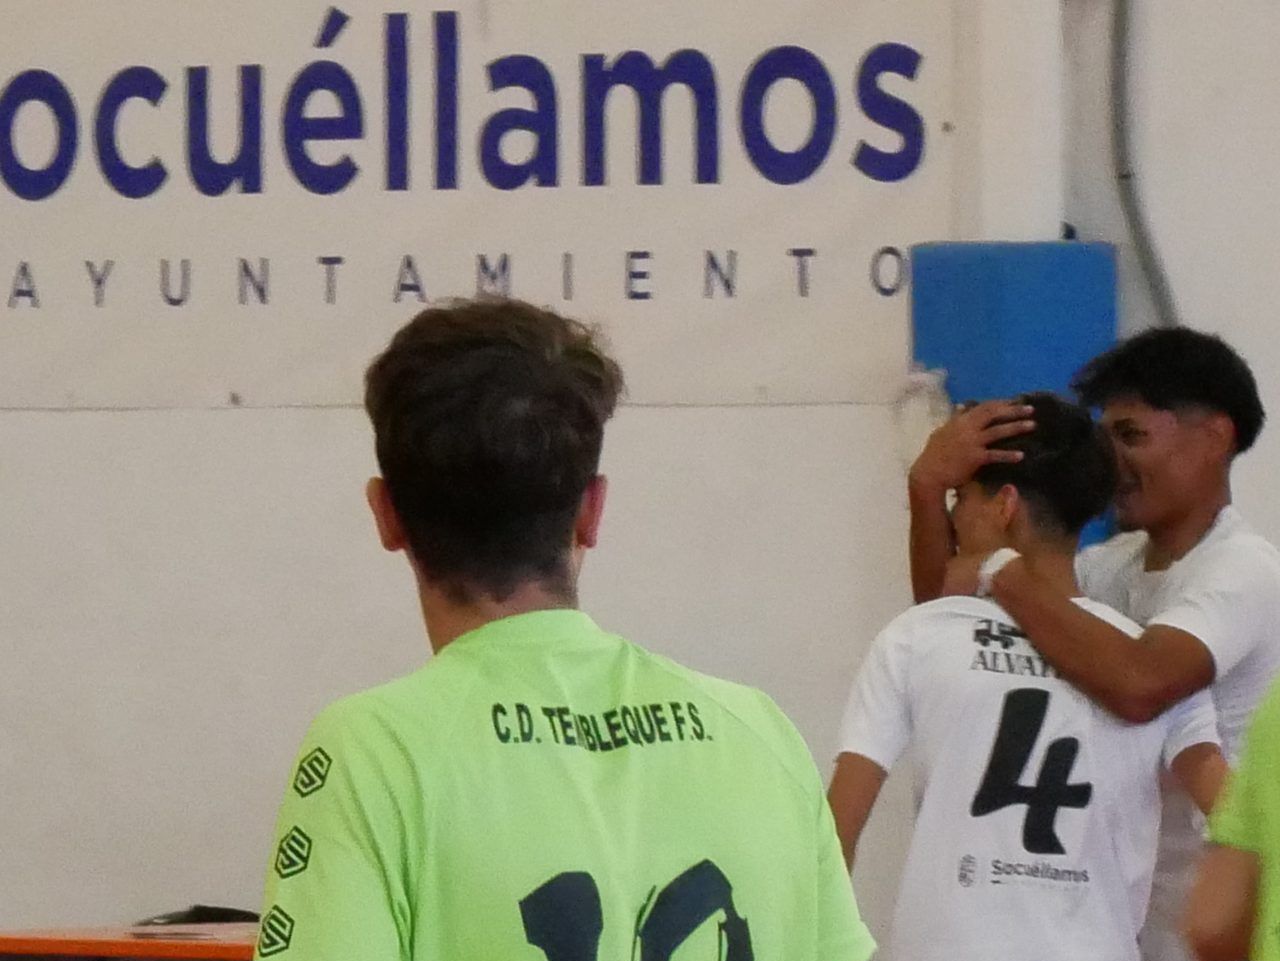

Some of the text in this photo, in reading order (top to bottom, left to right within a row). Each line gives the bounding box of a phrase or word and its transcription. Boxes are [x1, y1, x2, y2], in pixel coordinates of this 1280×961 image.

[7, 245, 911, 308] AYUNTAMIENTO
[491, 702, 542, 744] C.D.
[971, 687, 1092, 855] 4
